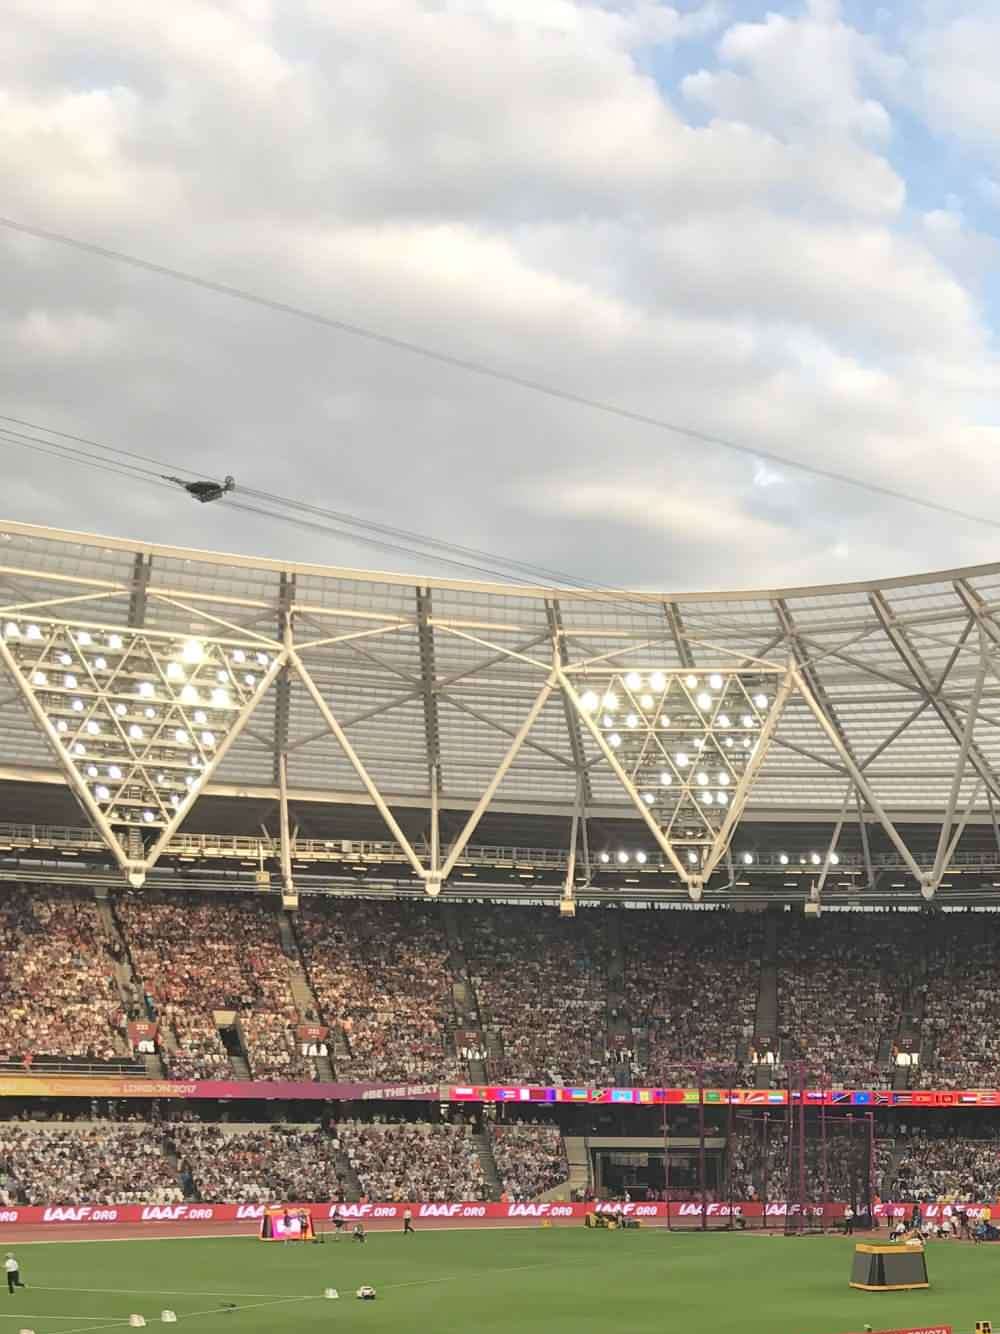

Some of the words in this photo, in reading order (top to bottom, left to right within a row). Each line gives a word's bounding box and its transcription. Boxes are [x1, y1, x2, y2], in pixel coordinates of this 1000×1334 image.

[383, 1087, 406, 1097] THE
[407, 1084, 439, 1096] NEXT
[43, 1207, 117, 1221] IAAF.ORG
[142, 1206, 212, 1219] IAAF.ORG
[419, 1203, 485, 1217] IAAF.ORG
[508, 1203, 572, 1216] IAAF.ORG
